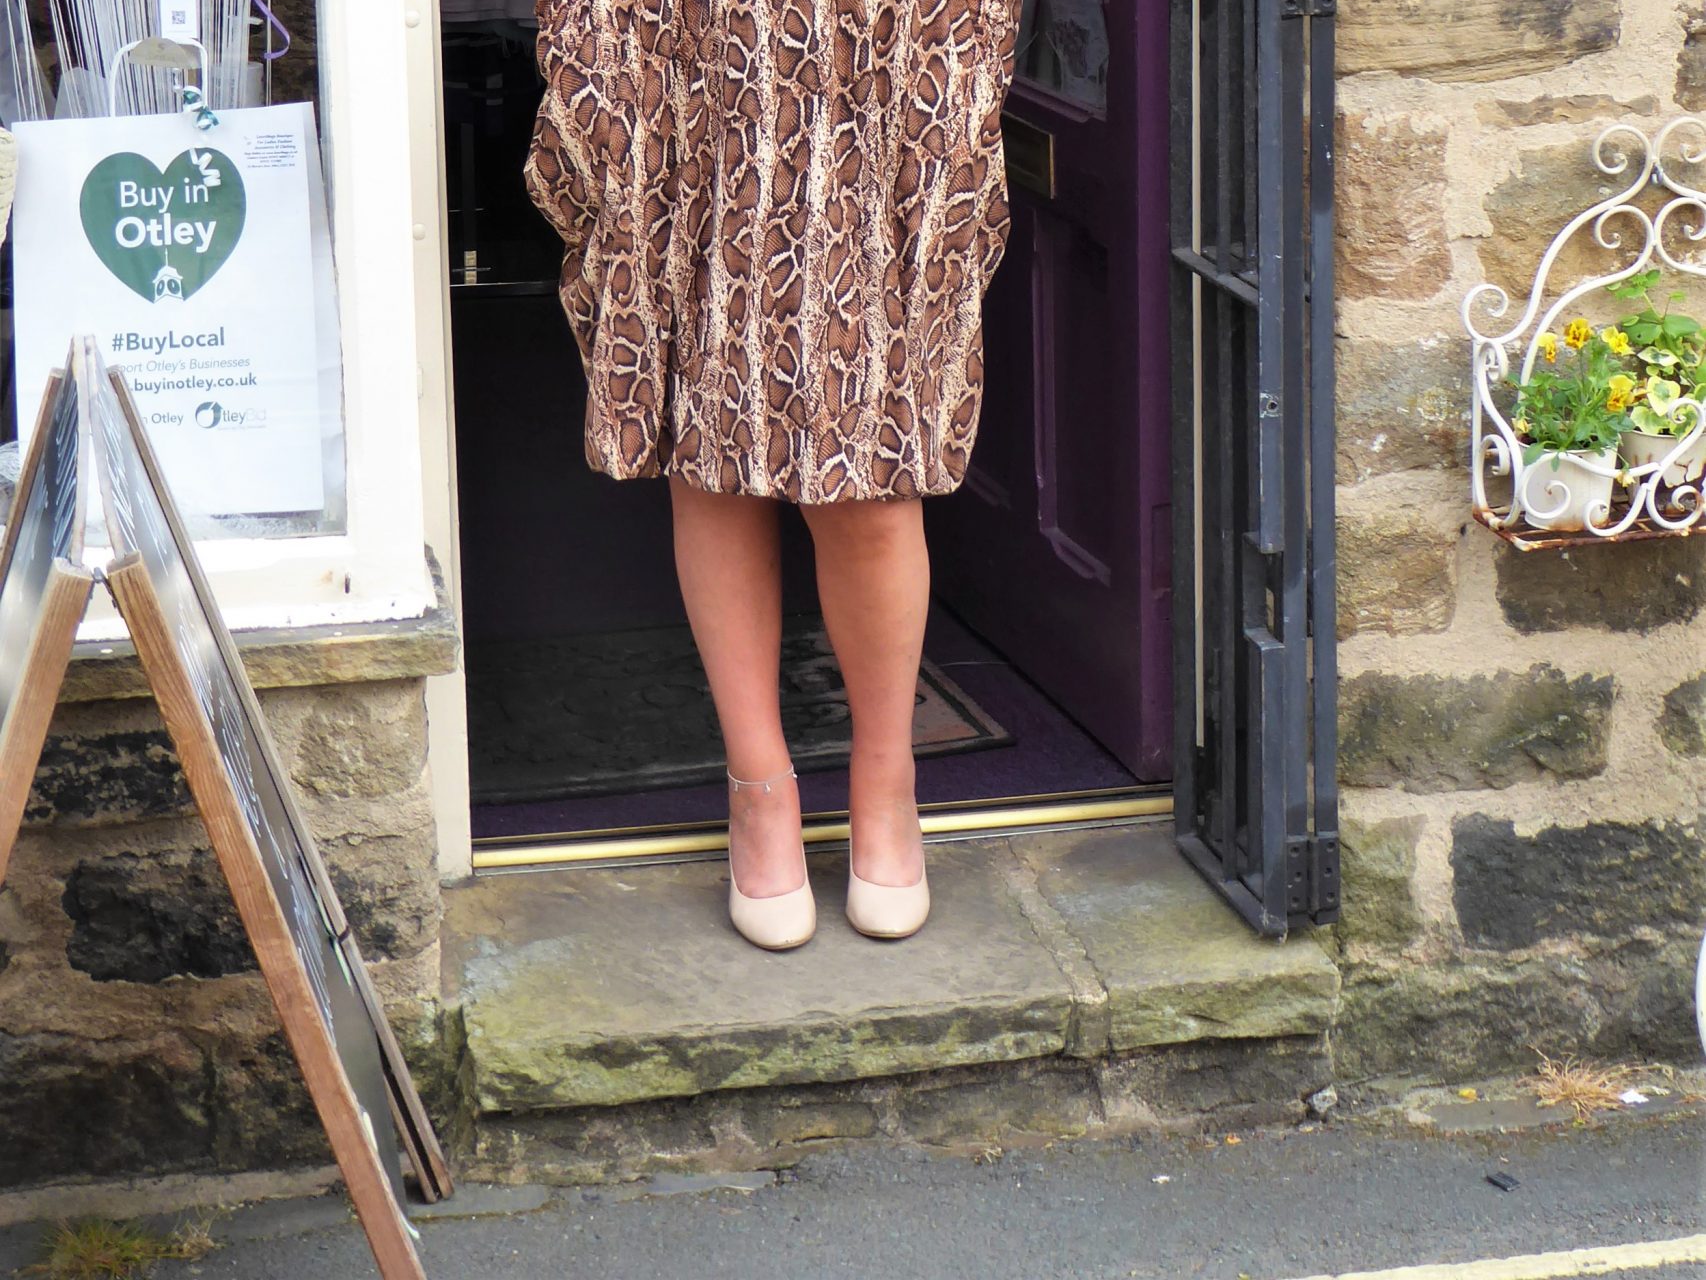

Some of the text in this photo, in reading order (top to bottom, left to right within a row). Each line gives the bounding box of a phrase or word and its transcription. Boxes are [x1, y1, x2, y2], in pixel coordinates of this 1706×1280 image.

[119, 177, 209, 214] Buy in
[115, 212, 217, 254] Otley
[112, 326, 225, 355] #BuyLocal
[189, 358, 251, 370] Businesses
[130, 372, 257, 394] .buyinotley.co.uk
[151, 412, 184, 426] Otley
